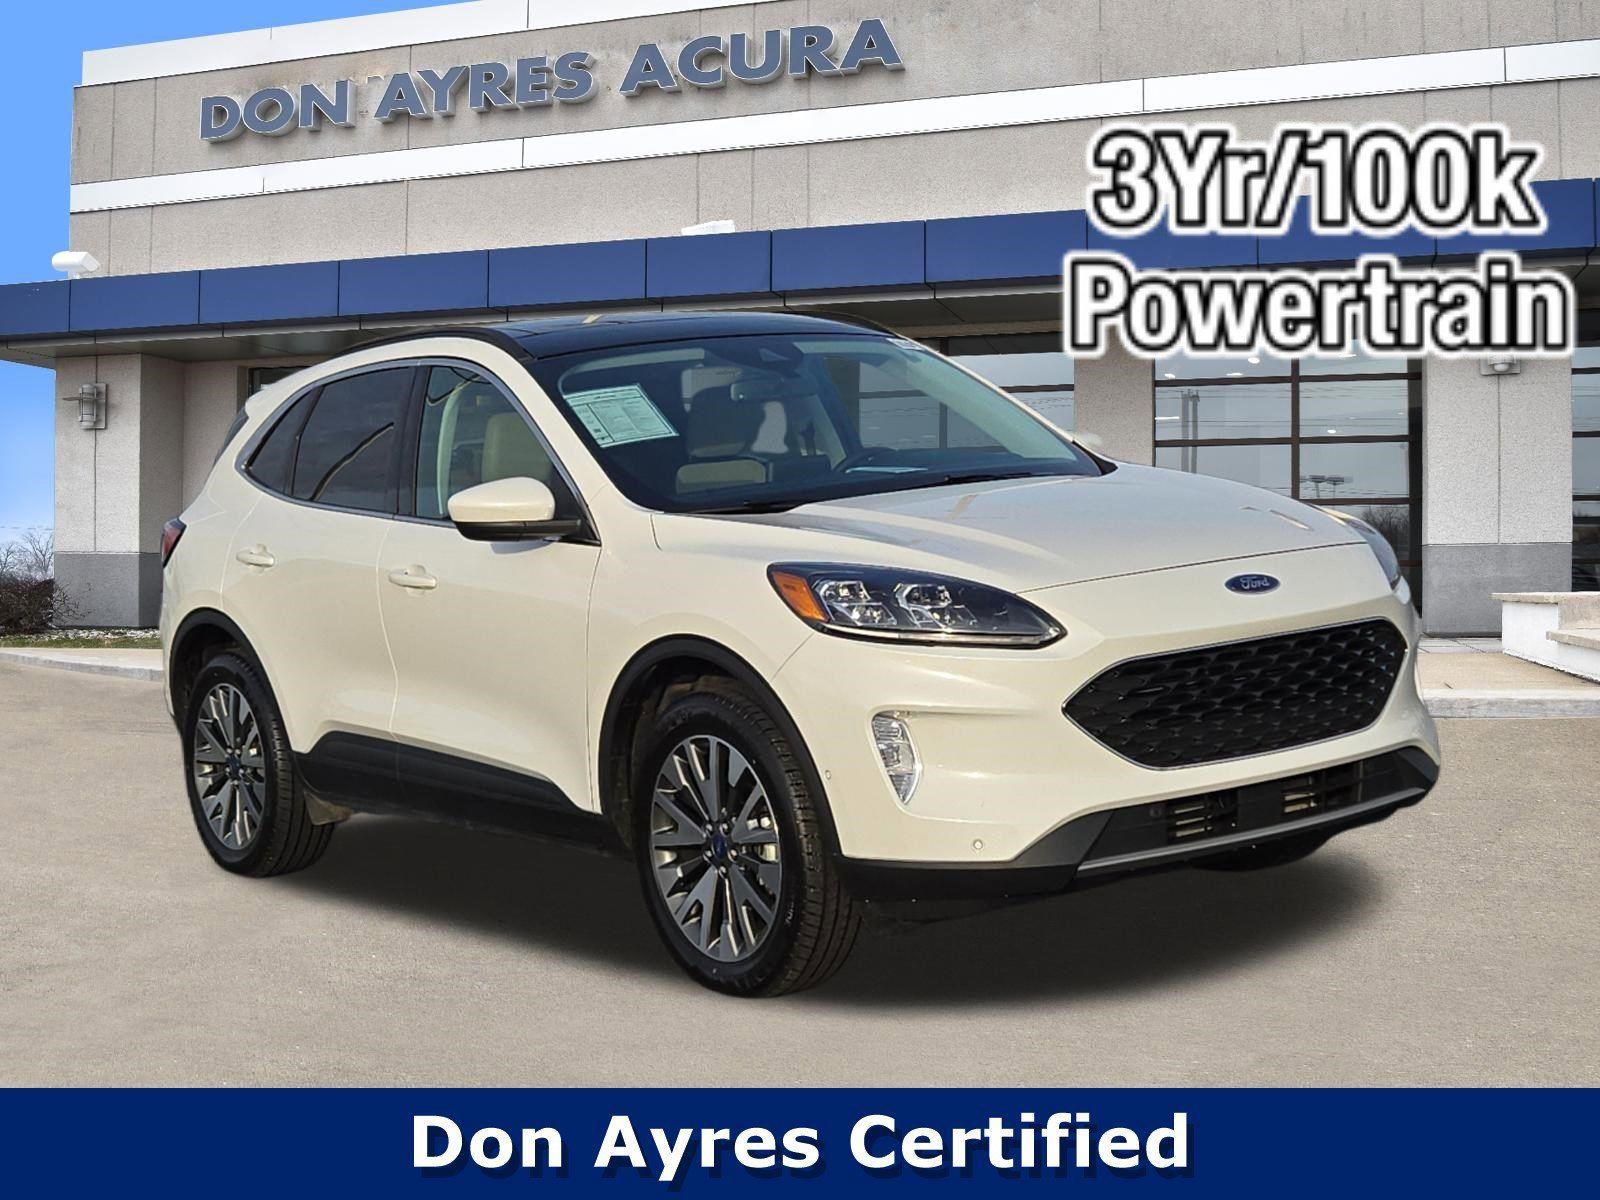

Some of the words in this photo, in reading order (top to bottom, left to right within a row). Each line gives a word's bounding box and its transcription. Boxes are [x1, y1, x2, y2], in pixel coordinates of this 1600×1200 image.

[200, 79, 355, 142] DON
[375, 50, 598, 122] AYRES
[619, 17, 905, 97] ACURA
[1240, 576, 1270, 589] Ford
